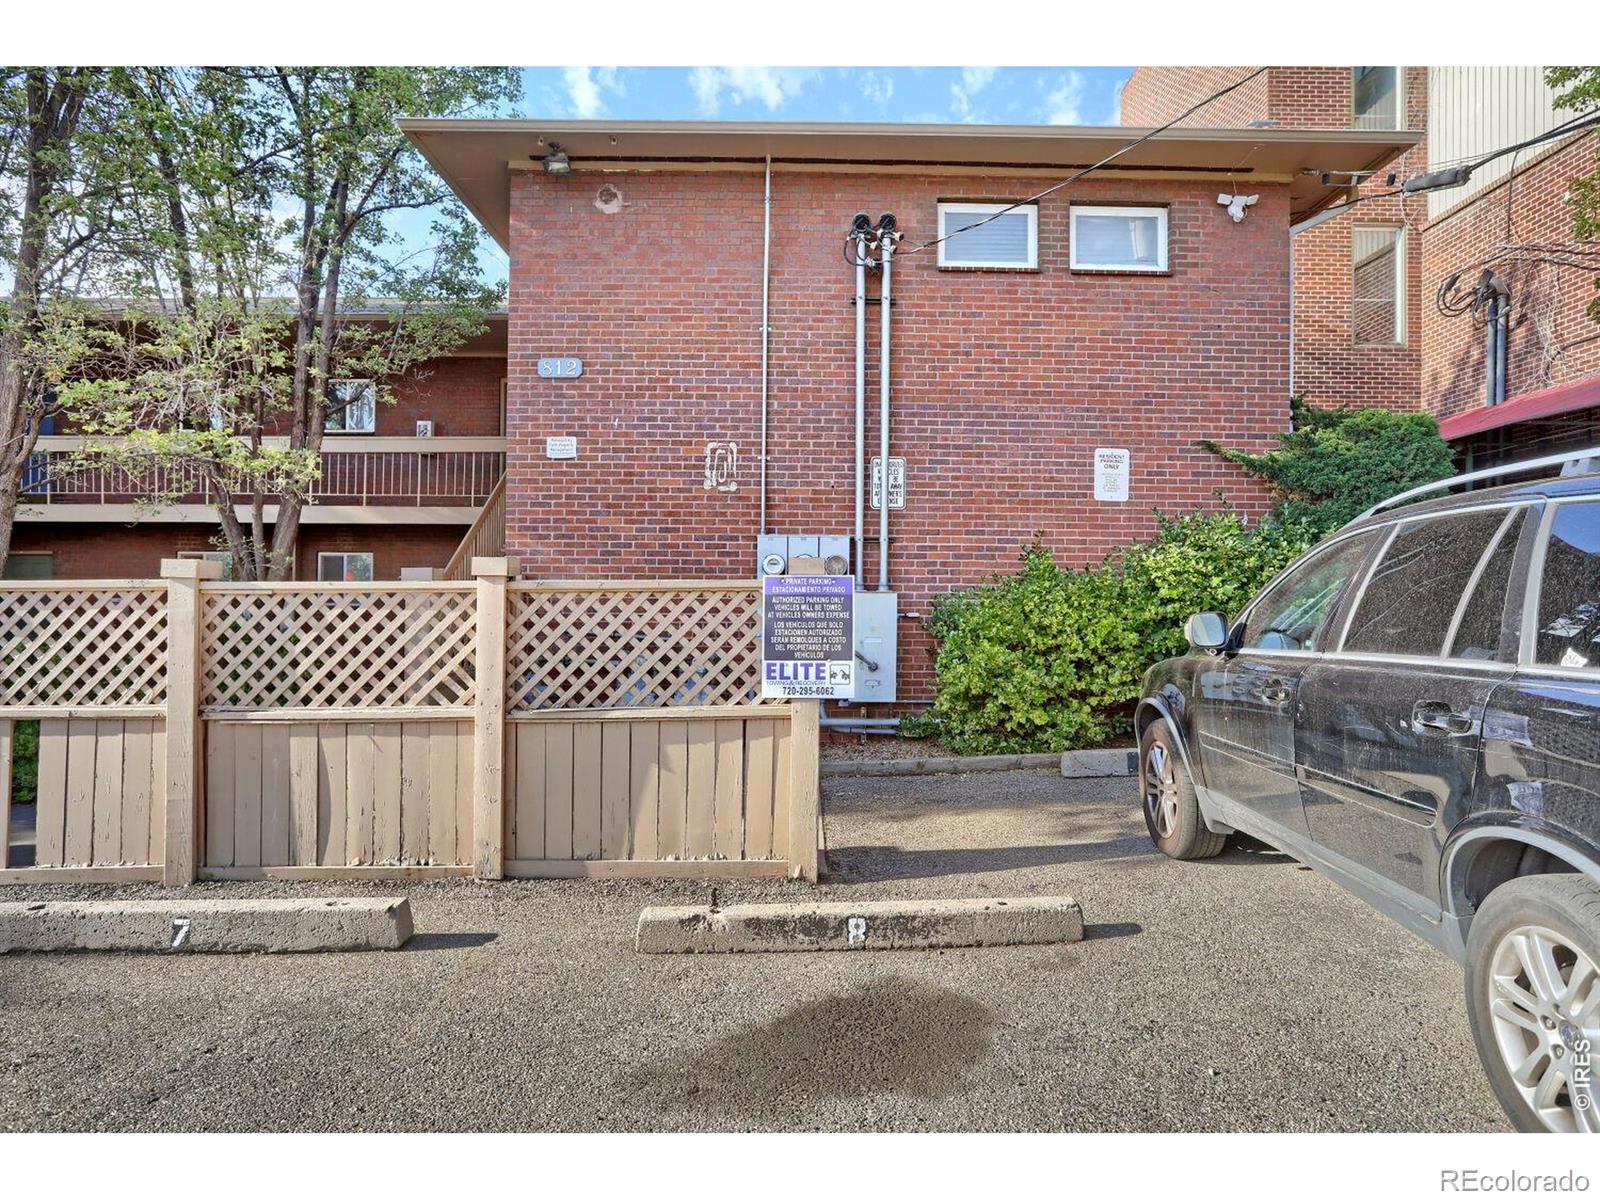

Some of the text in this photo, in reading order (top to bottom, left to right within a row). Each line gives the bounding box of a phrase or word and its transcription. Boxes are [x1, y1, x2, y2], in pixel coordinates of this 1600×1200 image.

[543, 360, 576, 376] 812
[771, 596, 845, 604] AUTHORIZED PARKING ONLY
[775, 611, 801, 619] VEHICLES
[801, 611, 825, 619] OWNERS
[825, 611, 850, 619] EXPENSE
[789, 636, 822, 644] REMOLQUES
[766, 662, 827, 681] ELITE
[782, 686, 835, 696] 720-295-6062
[172, 918, 191, 947] 7
[848, 917, 866, 946] 8
